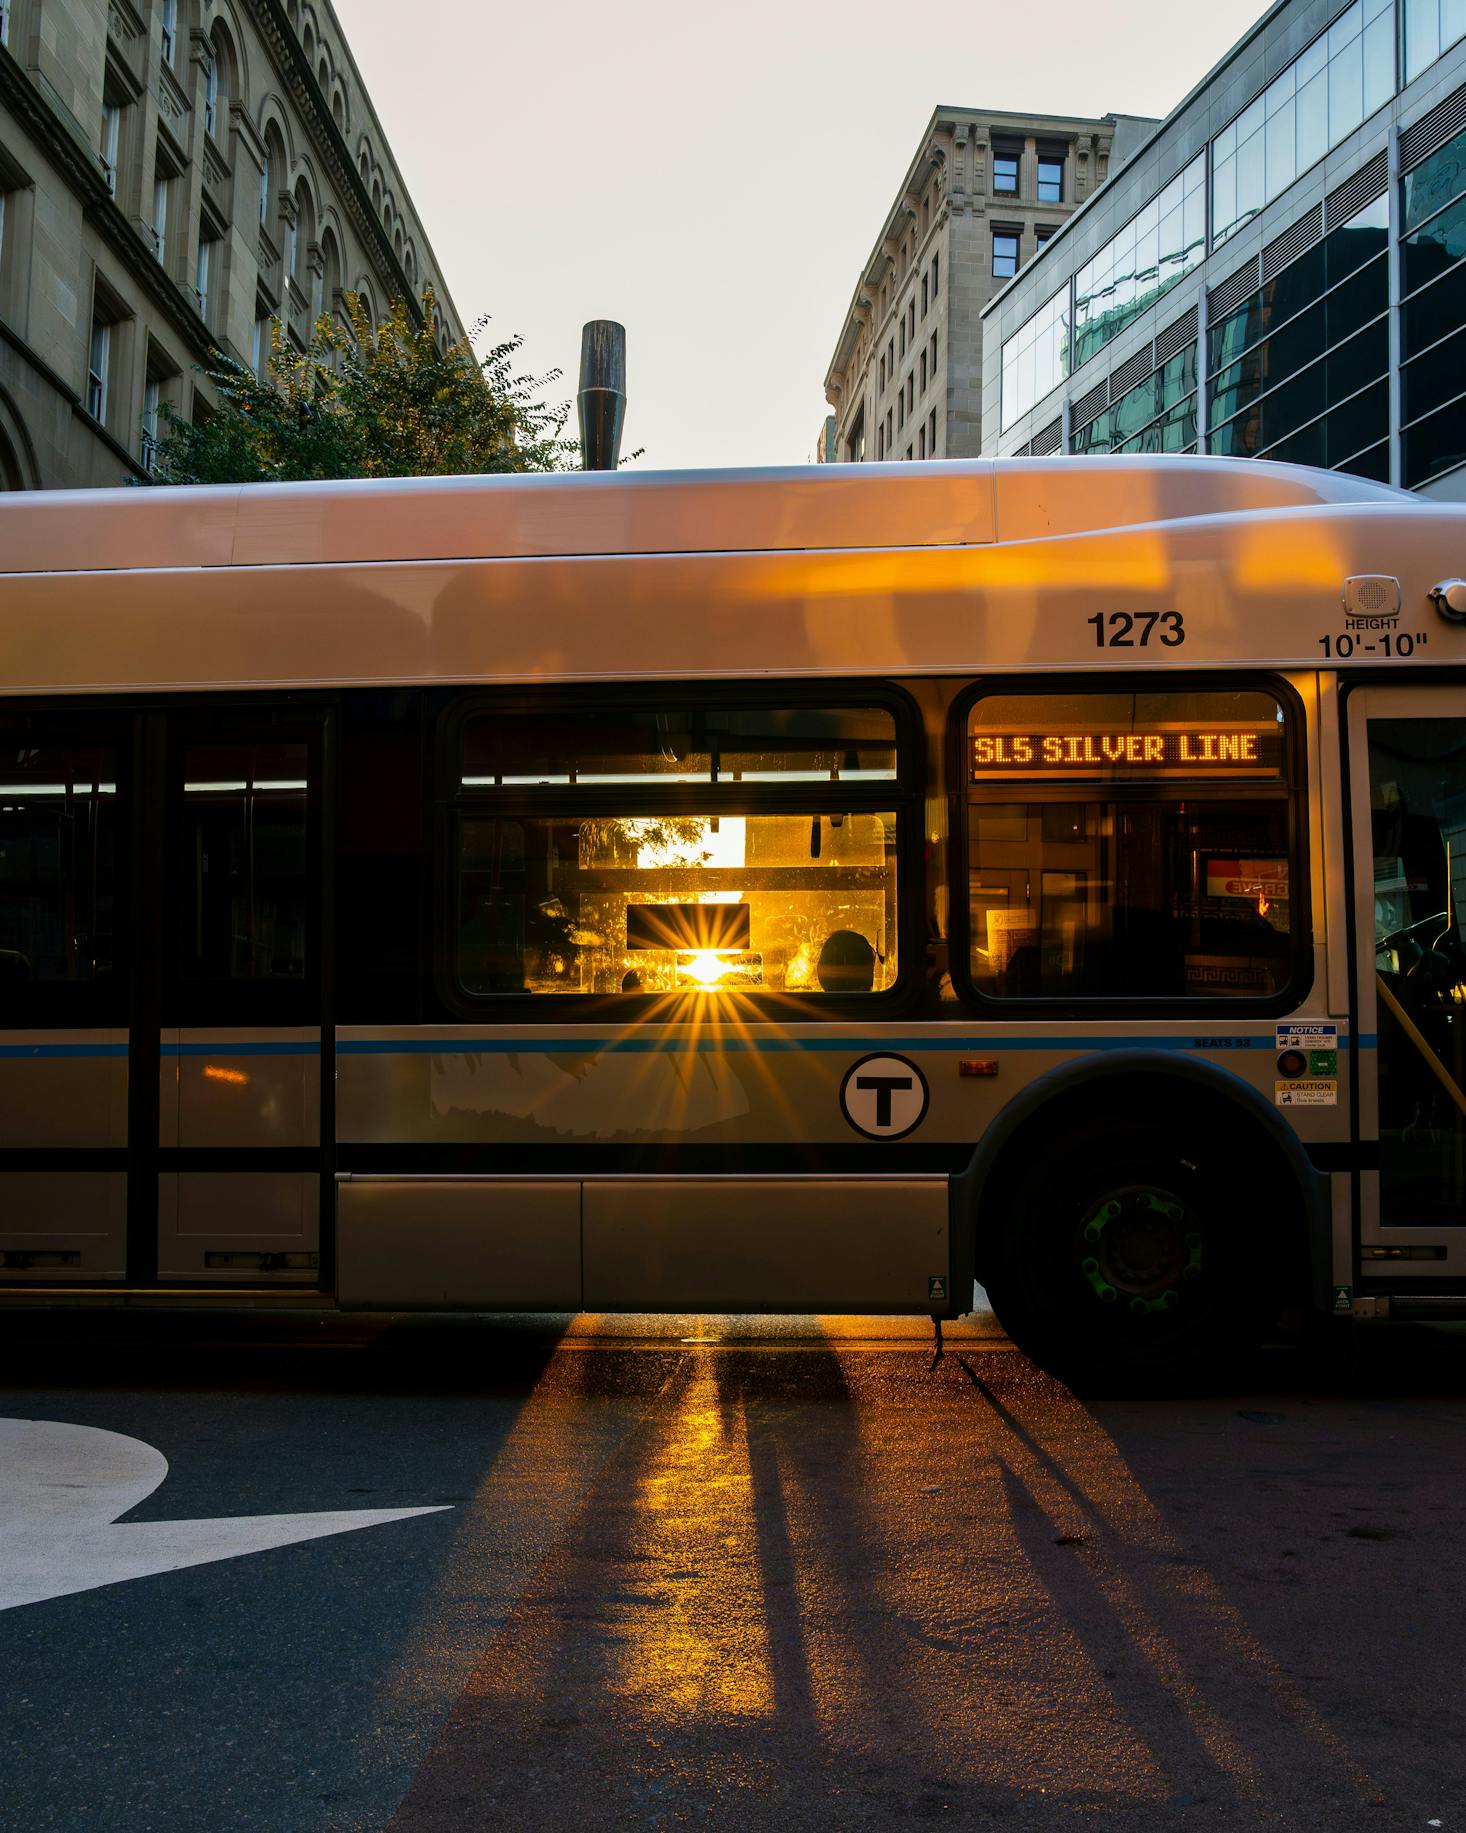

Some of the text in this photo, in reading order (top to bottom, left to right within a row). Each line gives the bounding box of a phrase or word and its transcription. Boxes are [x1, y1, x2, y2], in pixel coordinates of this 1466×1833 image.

[1087, 611, 1186, 648] 1273
[1345, 618, 1400, 630] HEIGHT
[1318, 632, 1428, 658] 10'-10"
[974, 735, 1258, 763] SL5 SILVER LINE
[1193, 1038, 1251, 1048] SEATS 53
[1288, 1026, 1324, 1034] NOTICE
[856, 1076, 913, 1127] T
